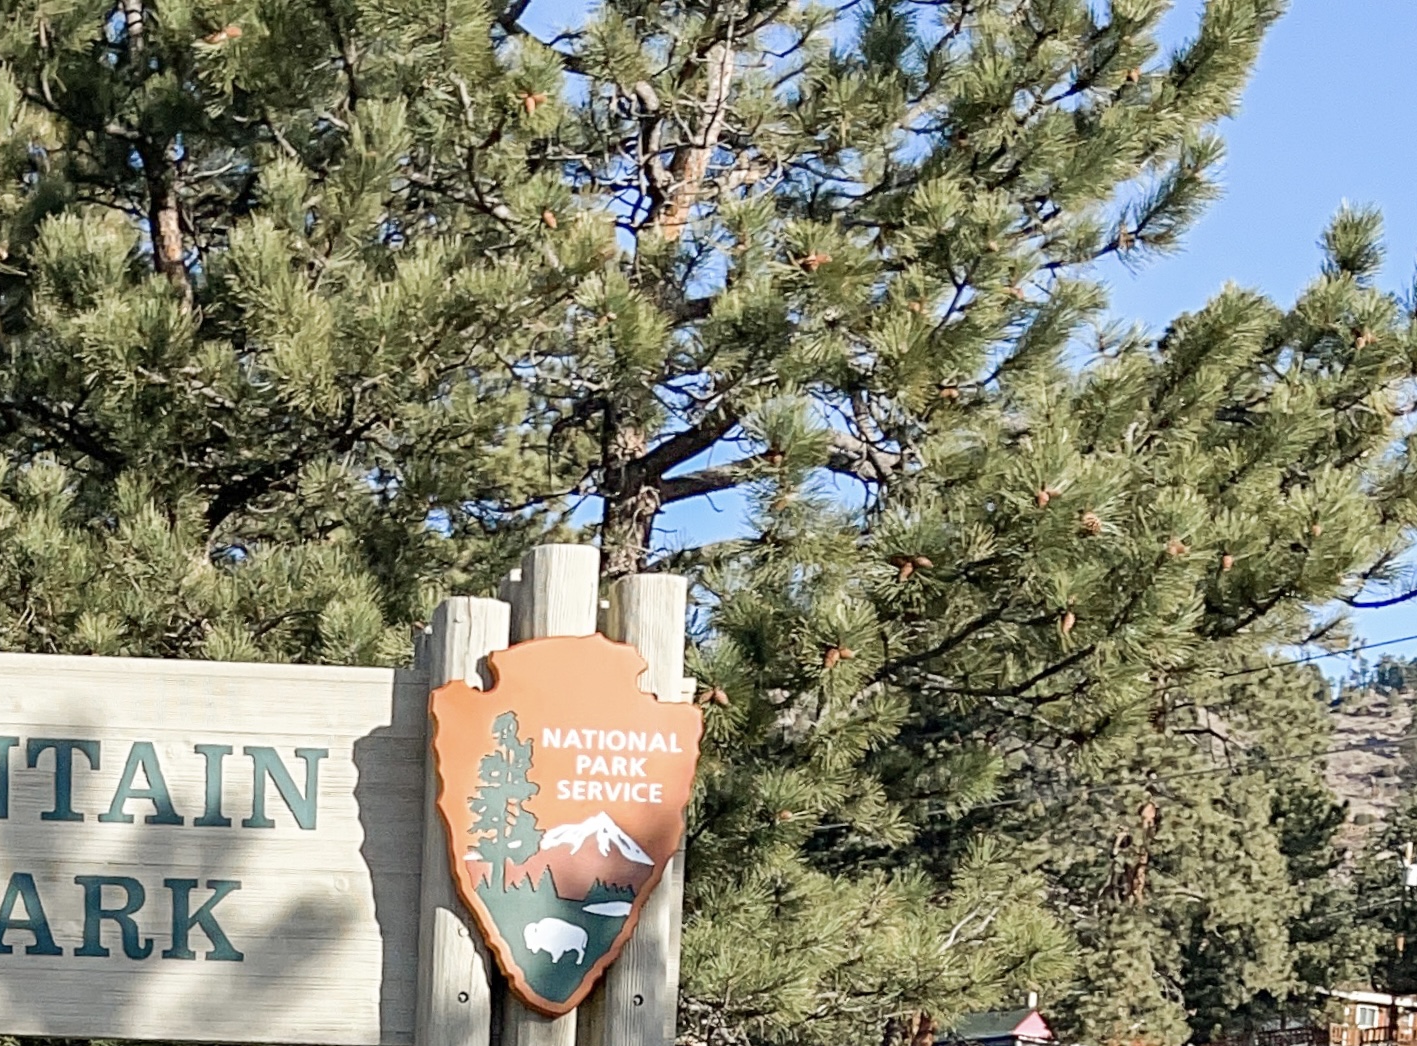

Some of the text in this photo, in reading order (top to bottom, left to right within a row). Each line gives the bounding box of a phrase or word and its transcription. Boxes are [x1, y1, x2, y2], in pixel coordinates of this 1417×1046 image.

[542, 728, 683, 754] NATIONAL
[575, 756, 647, 777] PARK
[556, 780, 663, 804] SERVICE
